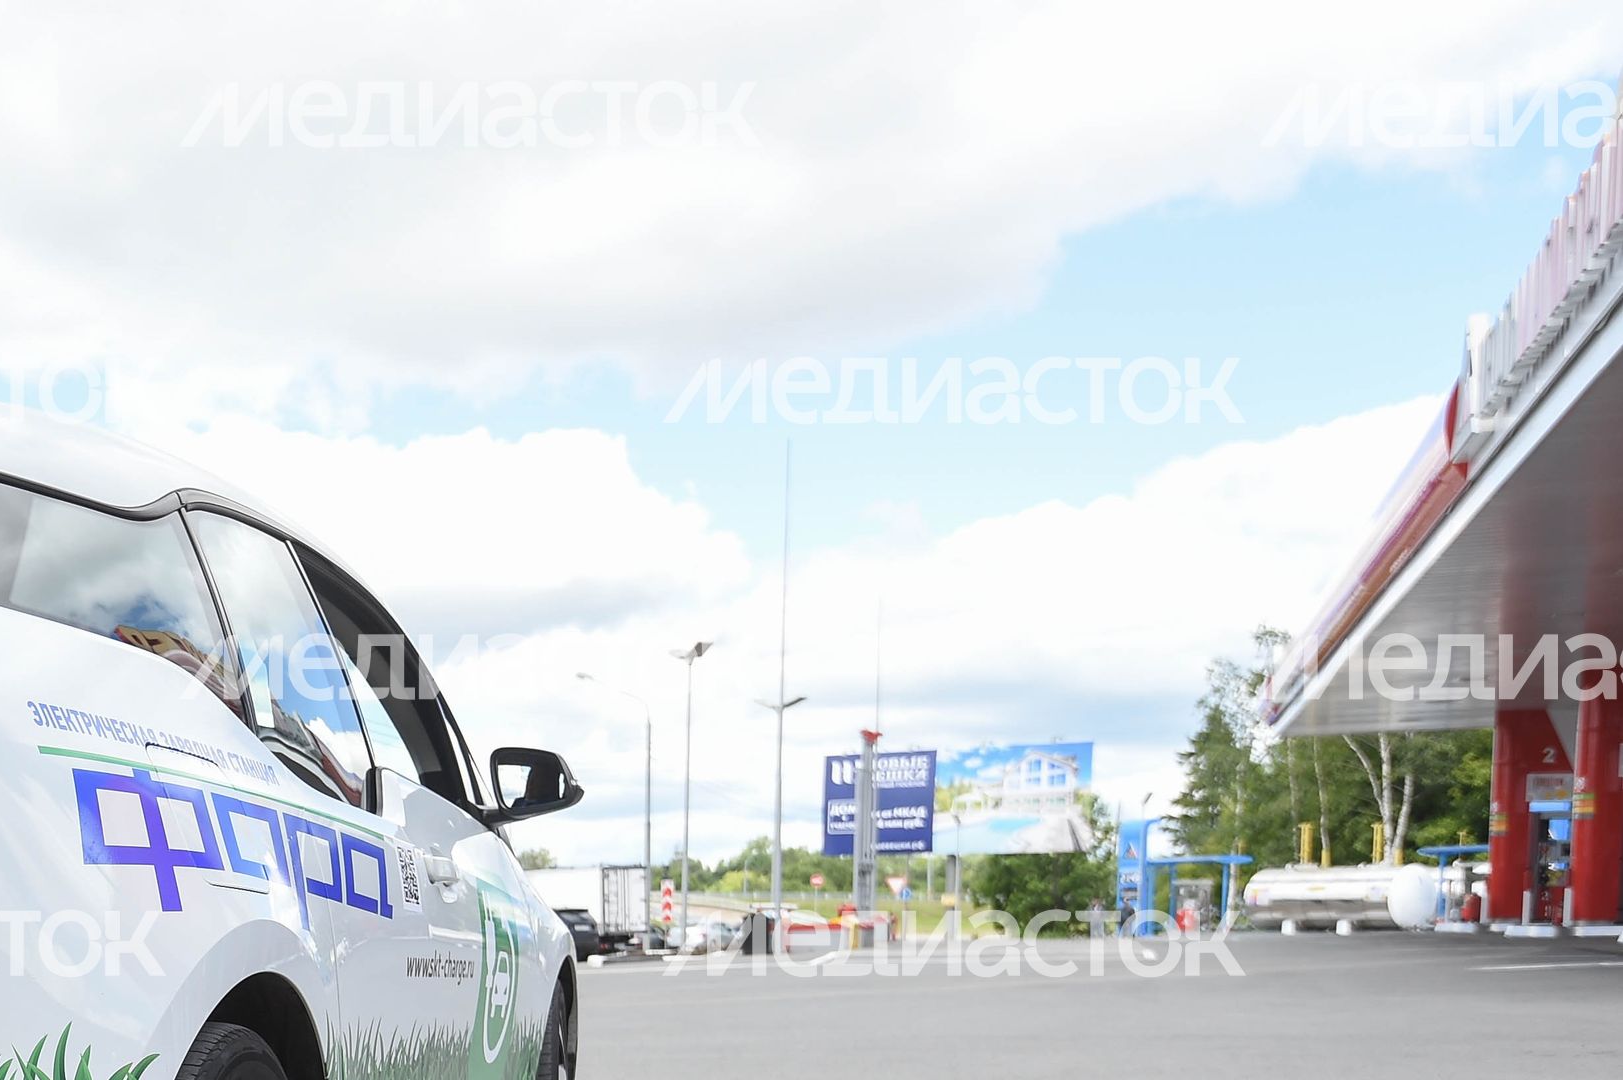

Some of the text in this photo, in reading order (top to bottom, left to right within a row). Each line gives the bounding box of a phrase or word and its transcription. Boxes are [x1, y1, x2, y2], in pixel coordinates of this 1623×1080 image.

[27, 700, 156, 746] ЭЛЕКТРИЧЕСКАЯ
[228, 752, 280, 786] СТАНЦИЯ
[1542, 747, 1556, 763] 2
[893, 806, 927, 818] МКАД
